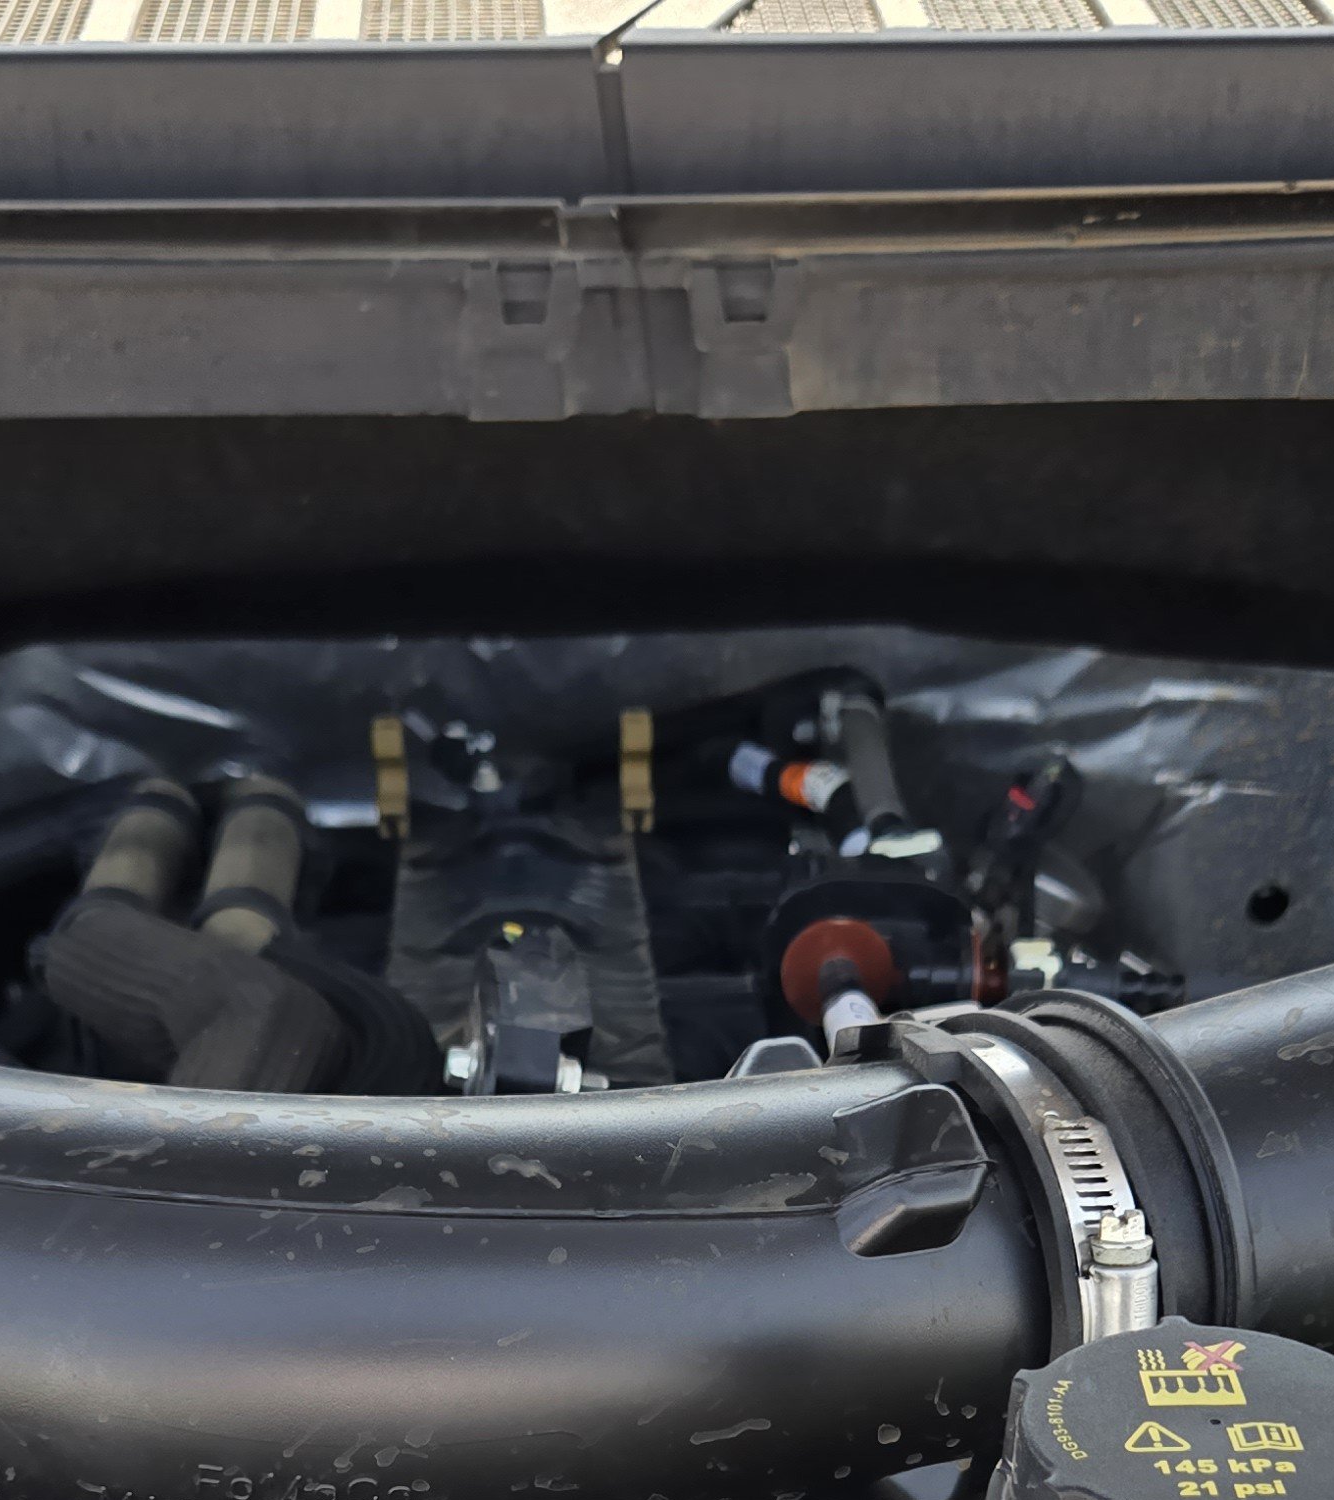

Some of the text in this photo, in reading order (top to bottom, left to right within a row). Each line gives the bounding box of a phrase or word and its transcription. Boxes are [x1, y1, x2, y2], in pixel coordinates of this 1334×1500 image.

[1046, 1380, 1088, 1460] DG93-8101-AA
[1153, 1458, 1297, 1475] 145 kPa
[1177, 1479, 1287, 1499] 21 psi
